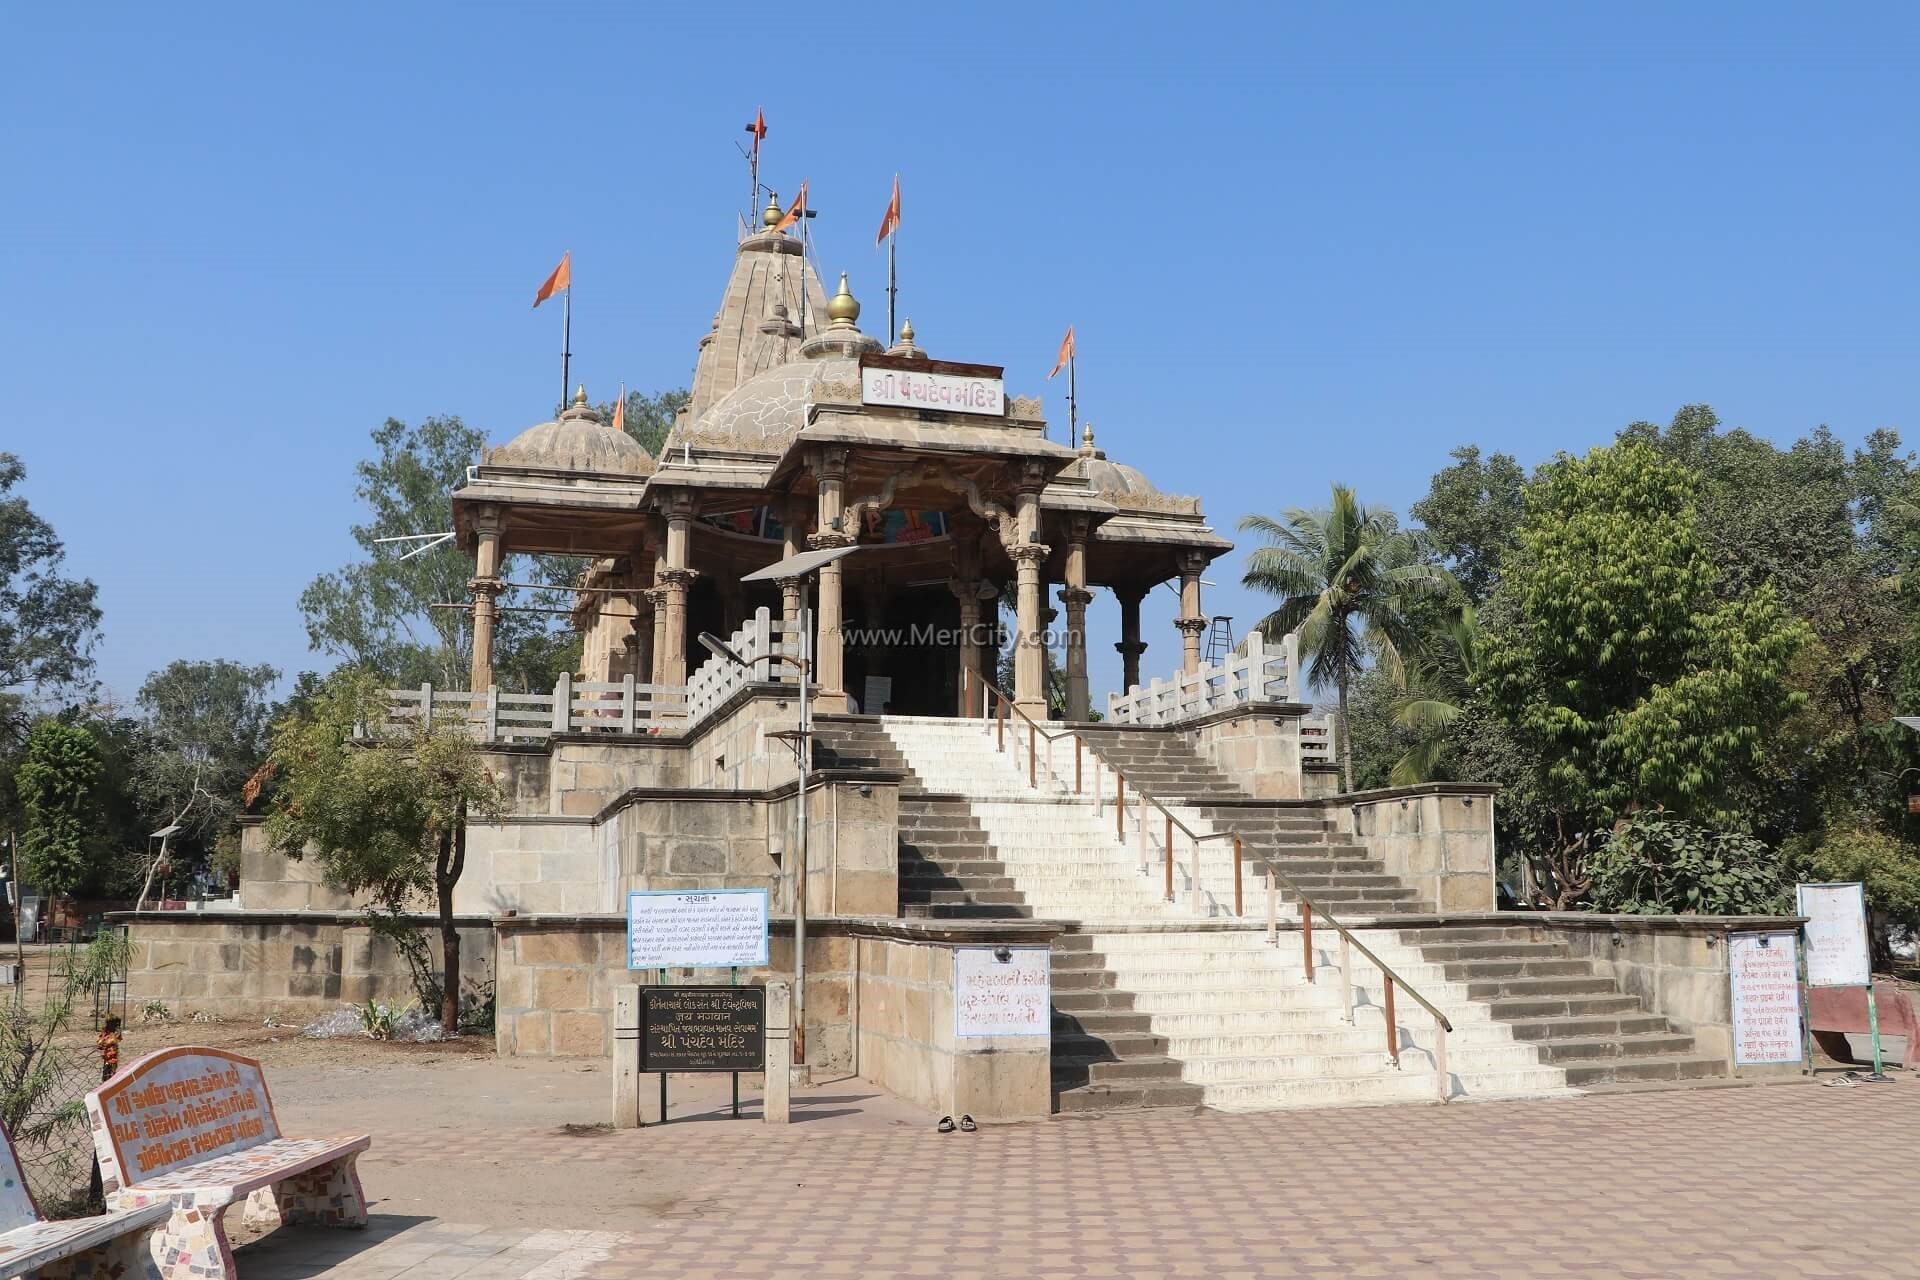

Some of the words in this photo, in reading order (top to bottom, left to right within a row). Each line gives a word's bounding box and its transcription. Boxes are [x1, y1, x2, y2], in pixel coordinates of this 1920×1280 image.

[872, 374, 895, 400] શ્રી
[711, 998, 721, 1010] શ્રી
[675, 1012, 692, 1022] जय
[697, 1012, 731, 1021] भगवान
[660, 1034, 677, 1049] શ્રી
[680, 1034, 715, 1049] પંચદેવ
[718, 1034, 745, 1049] મંદિર
